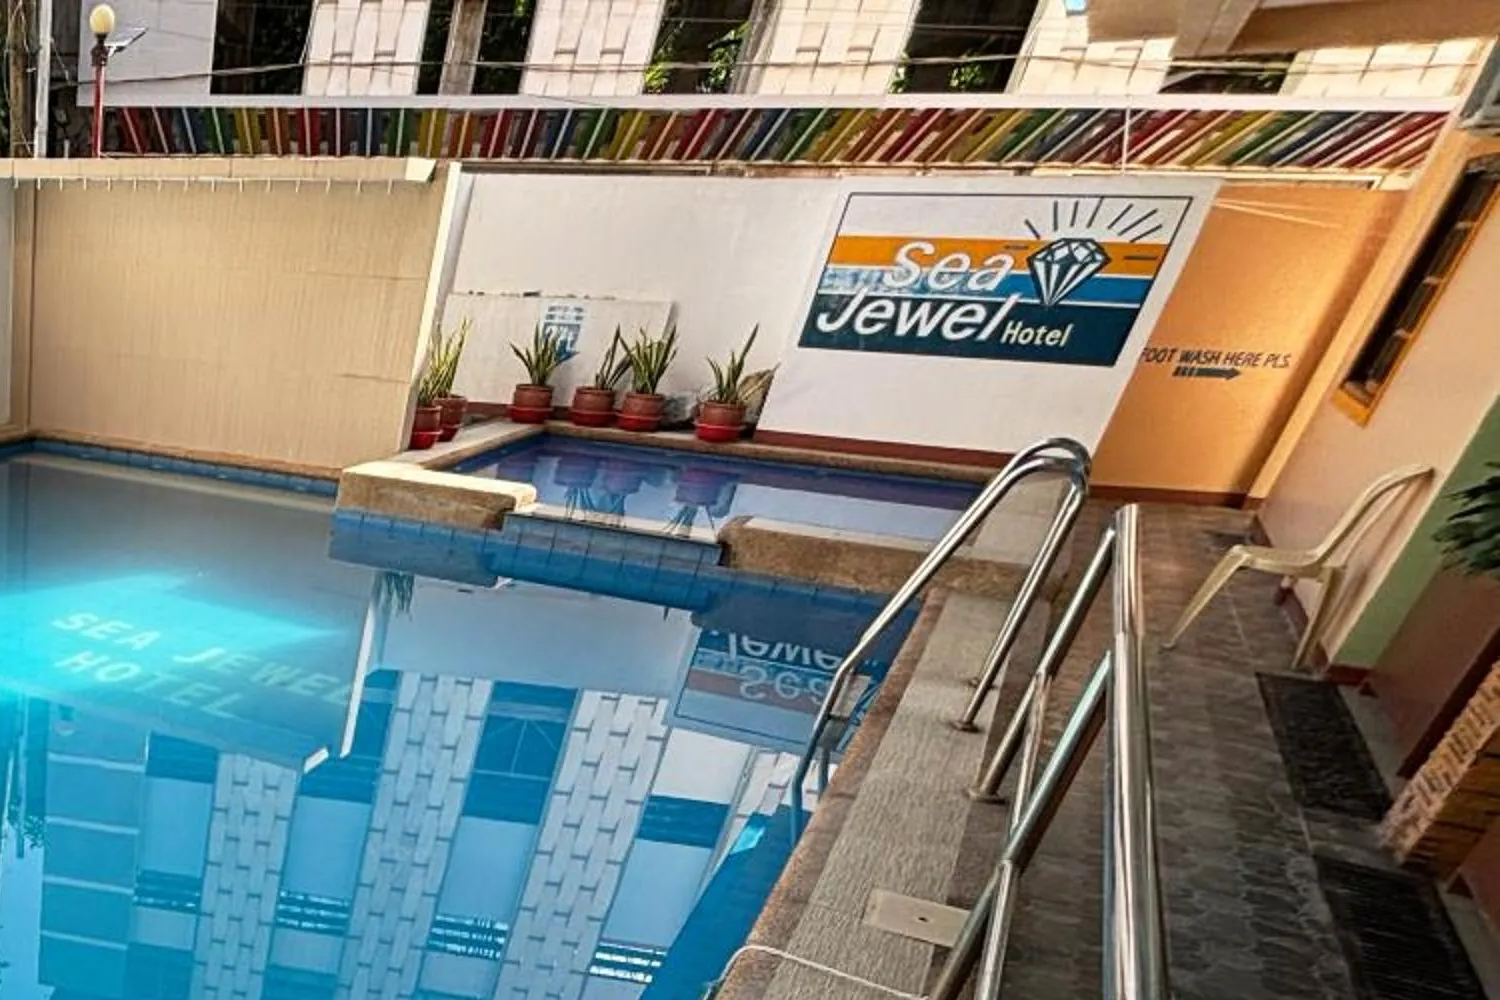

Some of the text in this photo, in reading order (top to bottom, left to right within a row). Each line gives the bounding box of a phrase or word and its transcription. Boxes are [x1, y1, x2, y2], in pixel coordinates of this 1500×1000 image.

[883, 241, 1015, 291] Sea
[816, 286, 1074, 347] Jewel Hotel
[1142, 347, 1177, 363] FOOT
[1179, 350, 1221, 364] WASH
[1222, 352, 1262, 367] HERE
[52, 612, 161, 651] SEA
[53, 652, 256, 723] HOTEL
